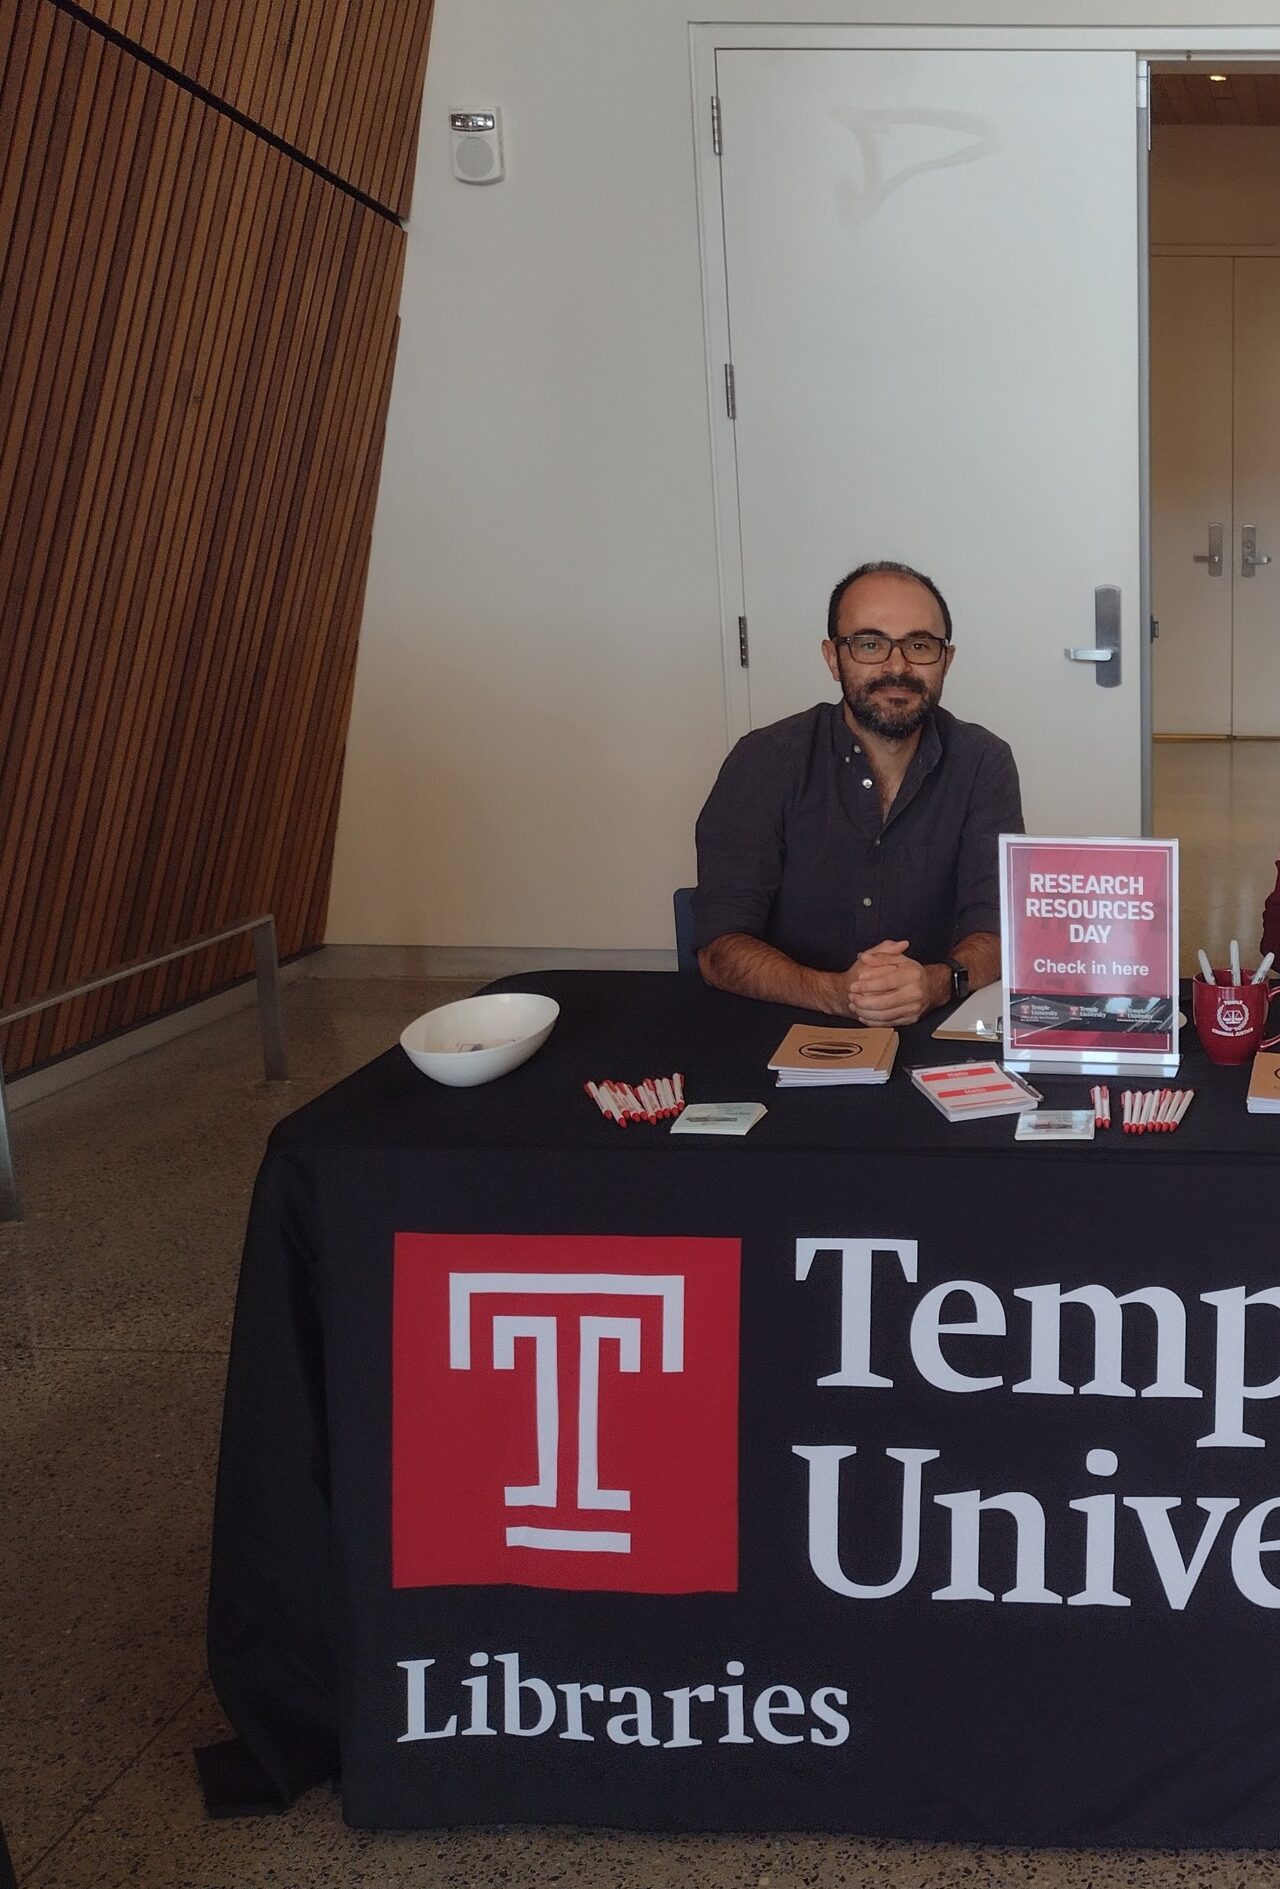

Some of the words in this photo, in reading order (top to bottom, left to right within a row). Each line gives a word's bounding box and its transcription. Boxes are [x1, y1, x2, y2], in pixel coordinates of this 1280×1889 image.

[1030, 873, 1144, 896] RESEARCH
[1026, 898, 1154, 921] RESOURCES
[1070, 924, 1111, 944] DAY
[1034, 958, 1086, 974] Check
[1092, 961, 1107, 976] in
[1112, 961, 1149, 976] here
[396, 1652, 850, 1748] Libraries
